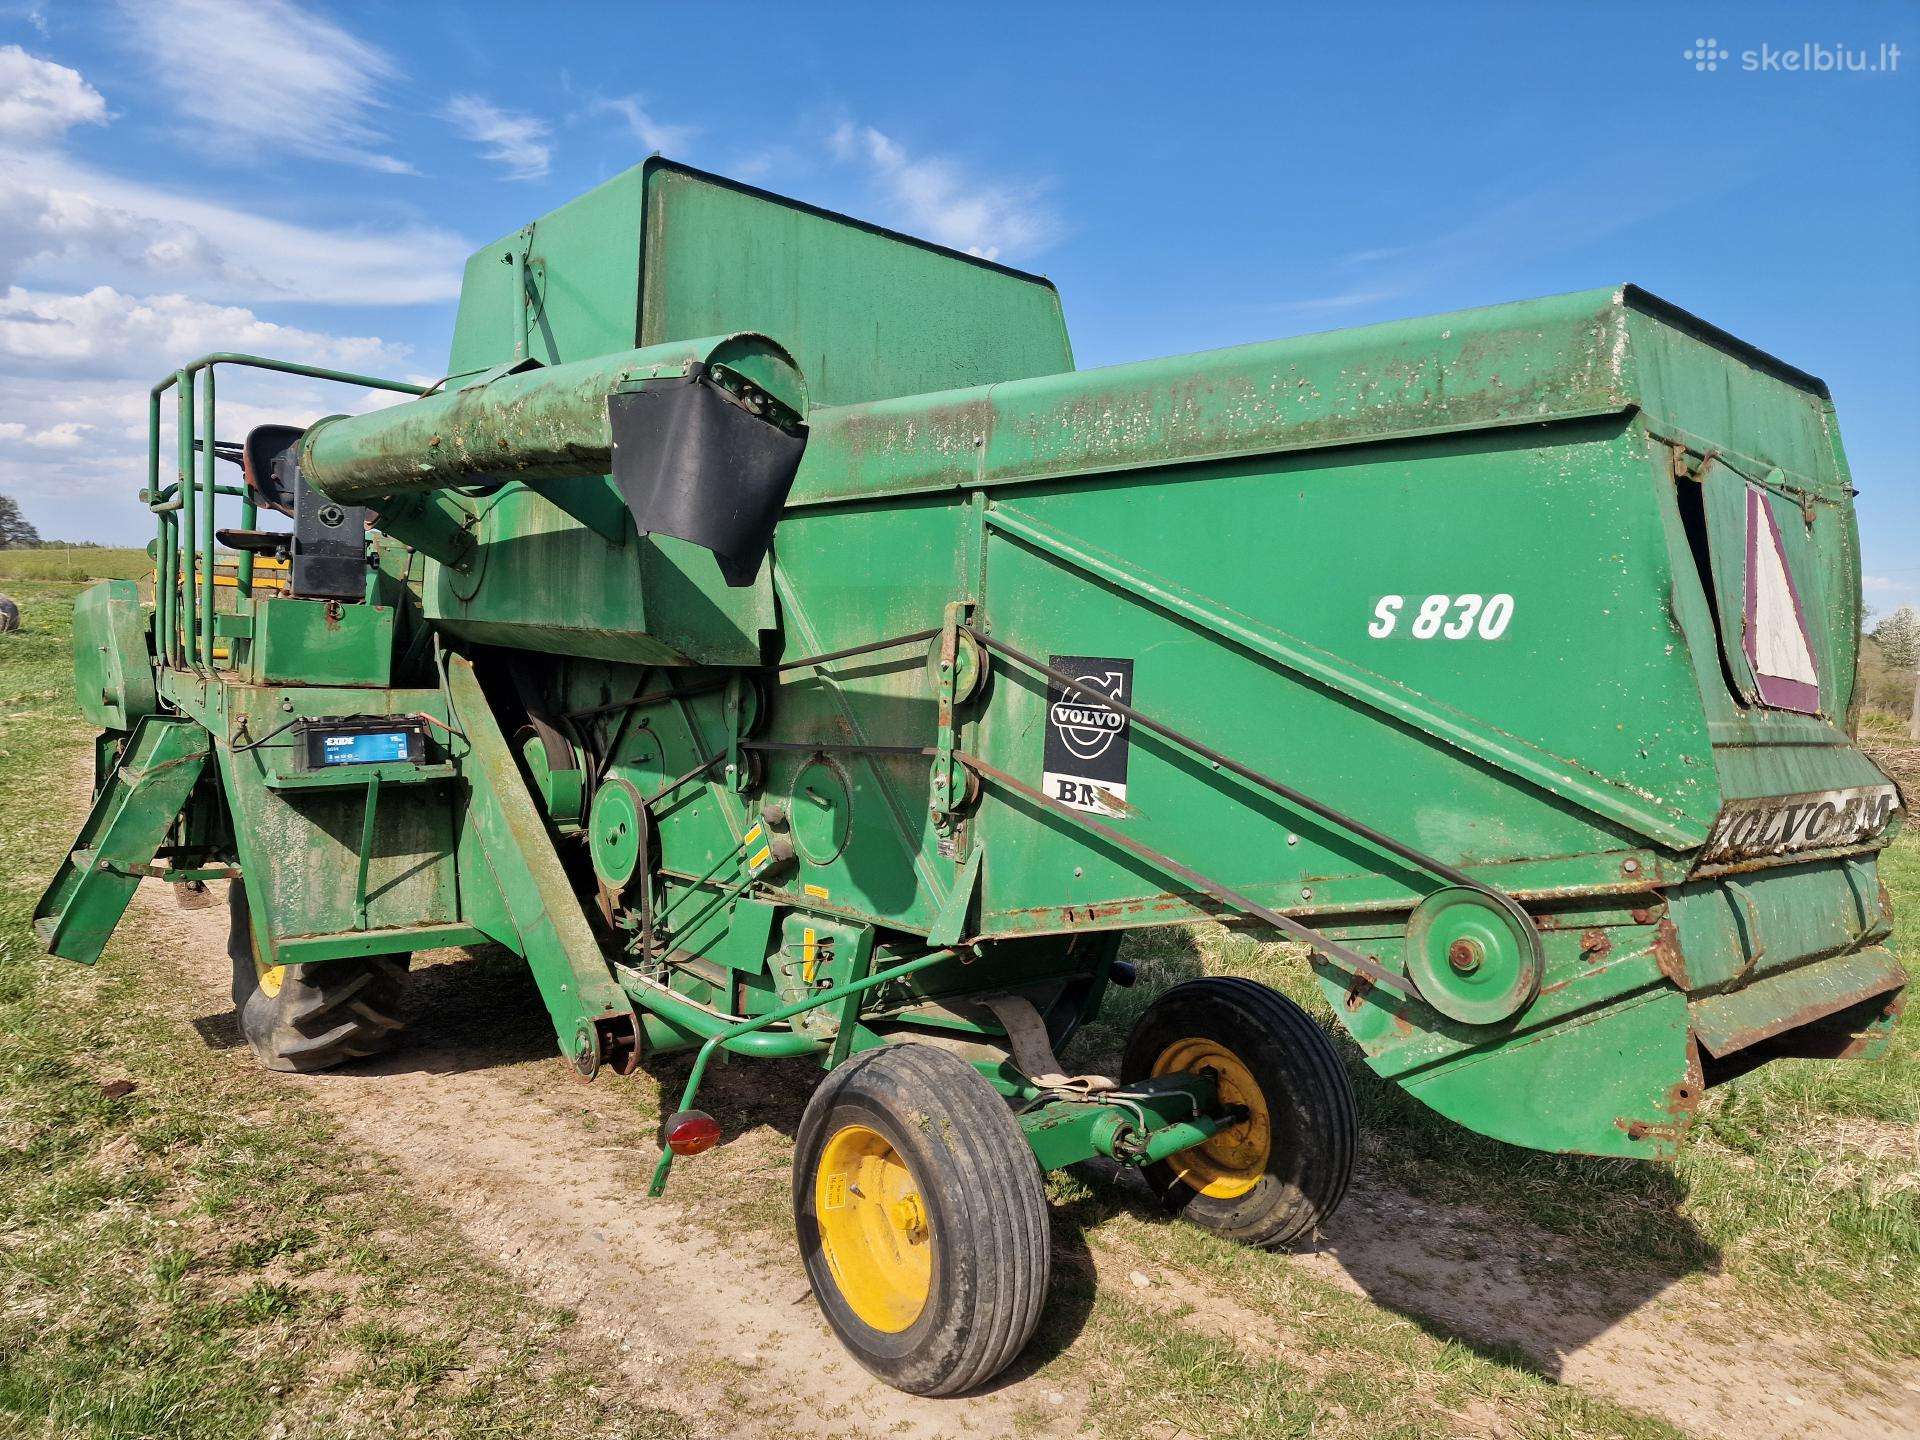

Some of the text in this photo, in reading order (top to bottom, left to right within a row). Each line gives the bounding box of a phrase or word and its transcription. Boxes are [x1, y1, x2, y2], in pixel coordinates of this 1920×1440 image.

[1368, 593, 1515, 640] S 830
[1055, 707, 1121, 728] VOLVO
[326, 736, 355, 746] EXIDE
